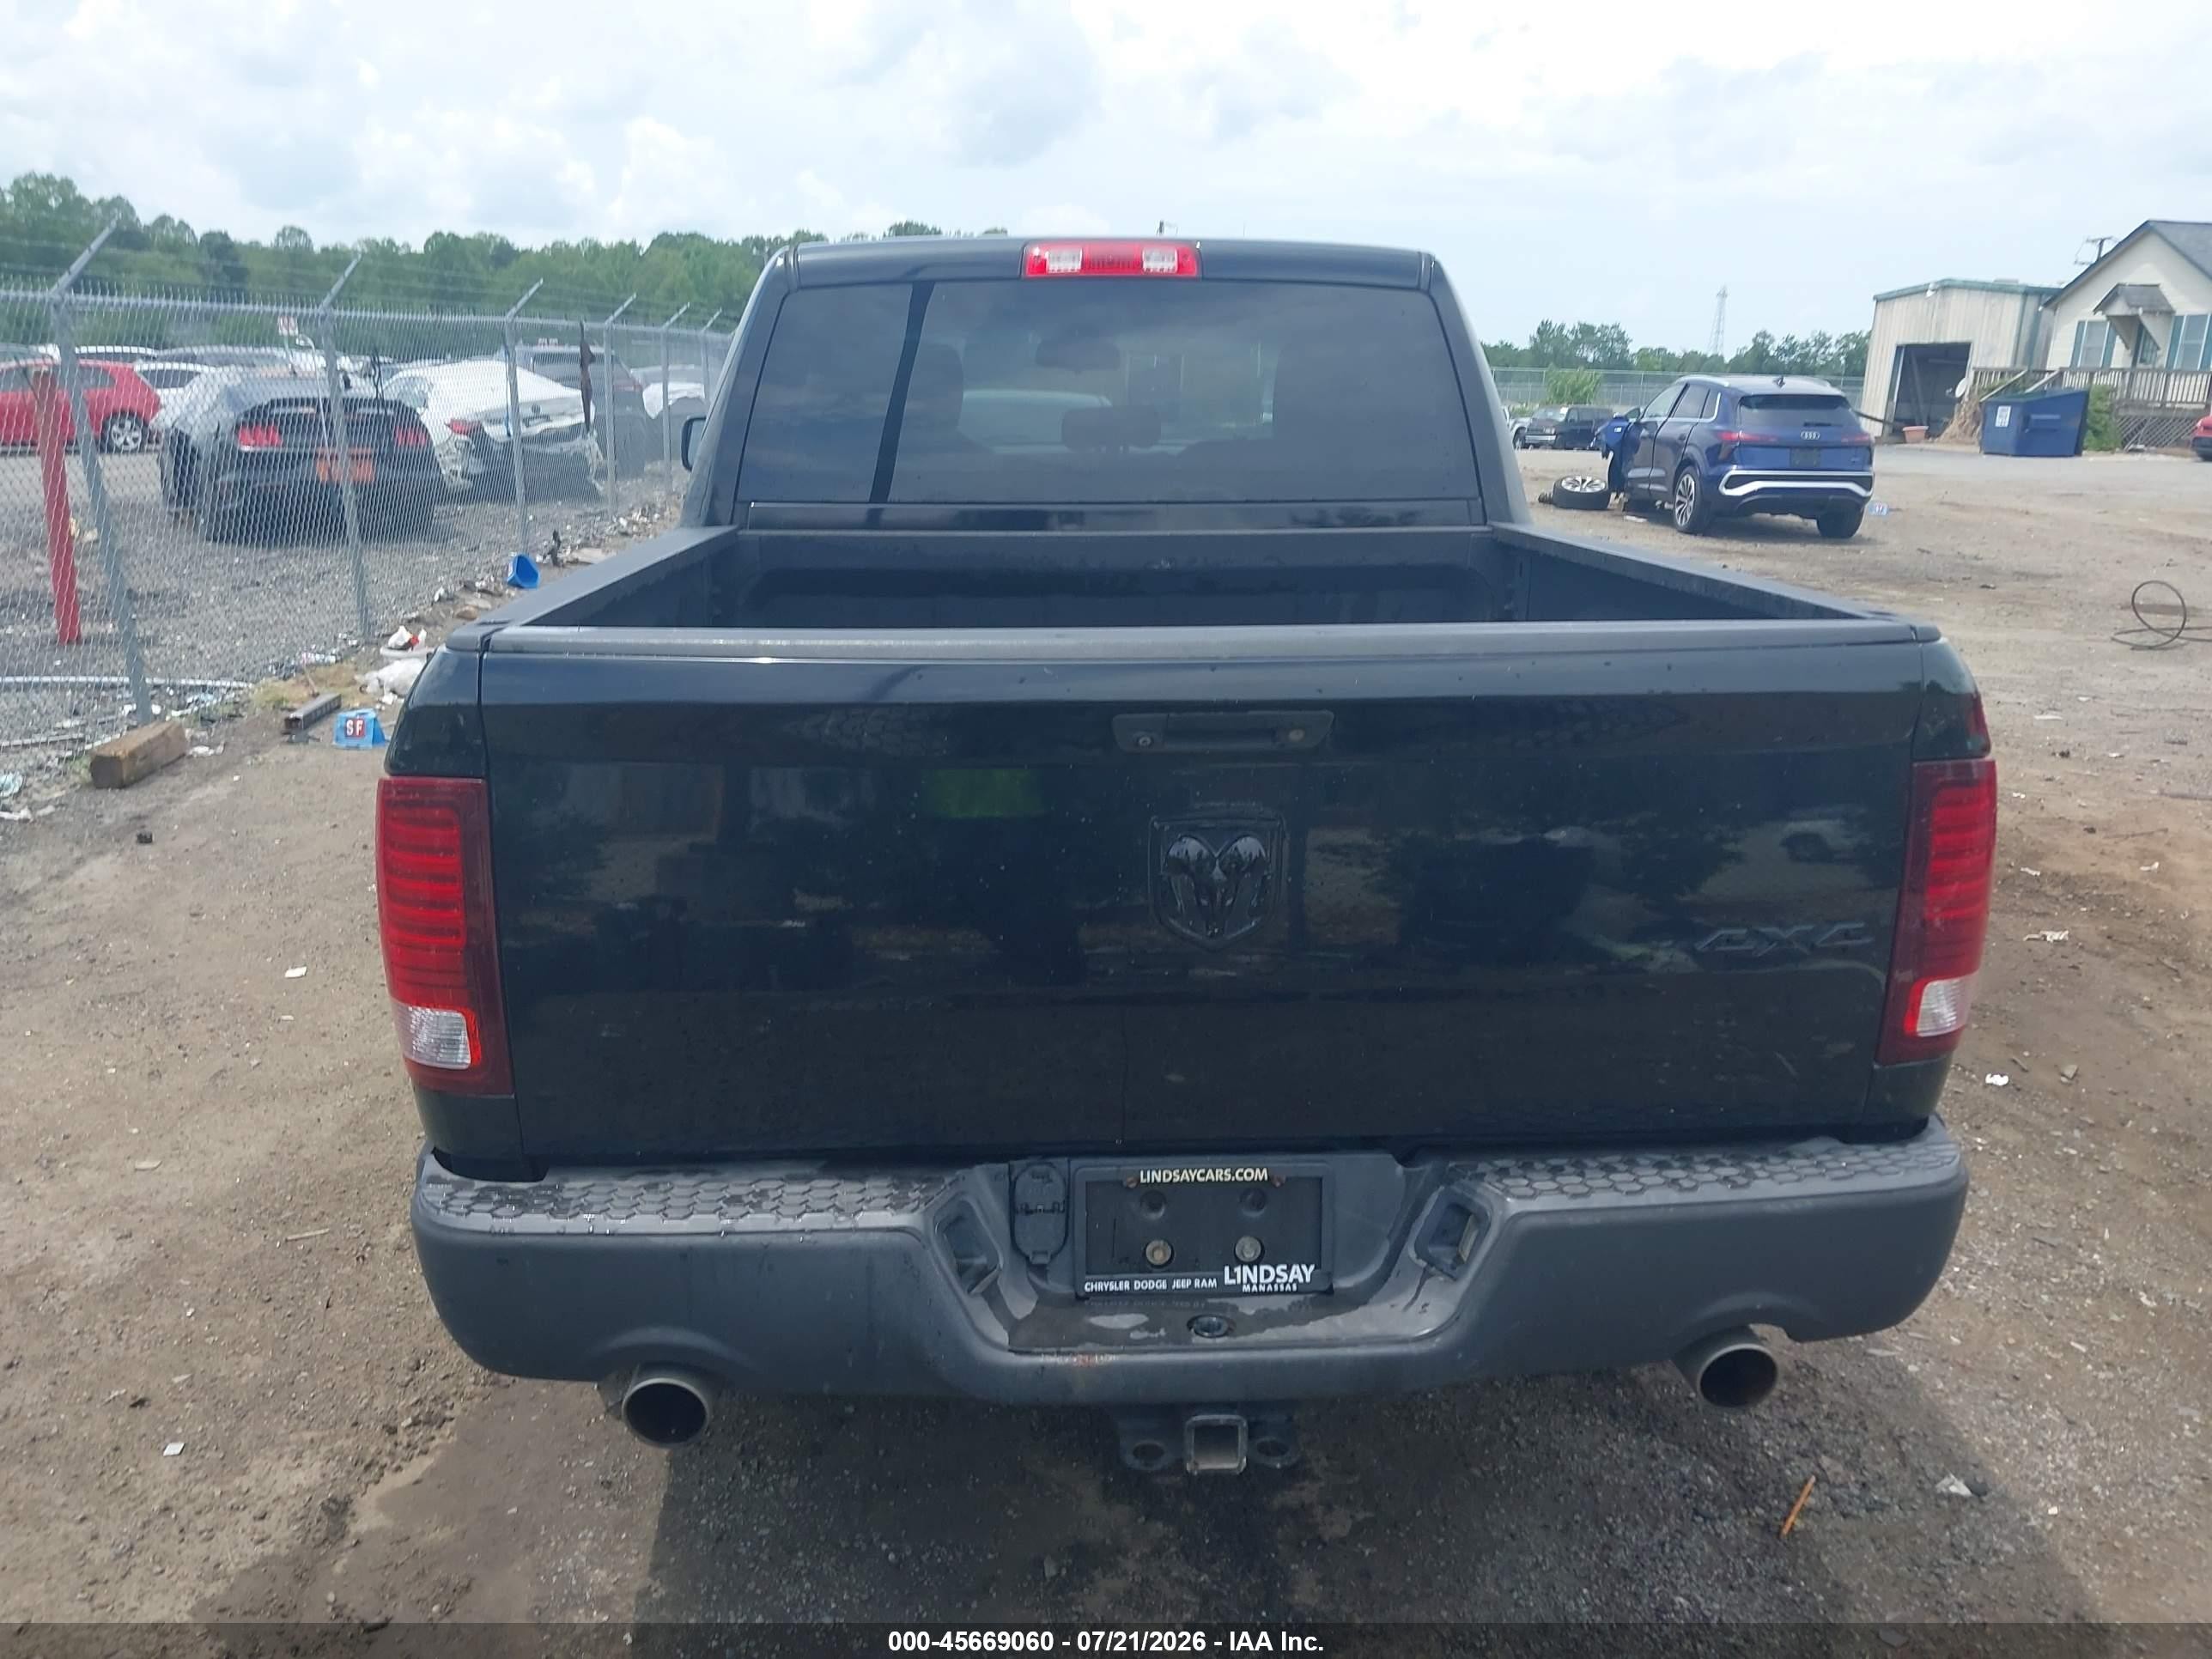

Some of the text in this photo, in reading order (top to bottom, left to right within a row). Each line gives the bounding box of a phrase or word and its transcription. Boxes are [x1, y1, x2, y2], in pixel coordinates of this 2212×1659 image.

[1139, 1168, 1269, 1183] LINDSAYCARS.COM
[1085, 1278, 1218, 1292] CHRYSLER DODGE JEEP RAM
[1243, 1284, 1297, 1293] MANASSAS
